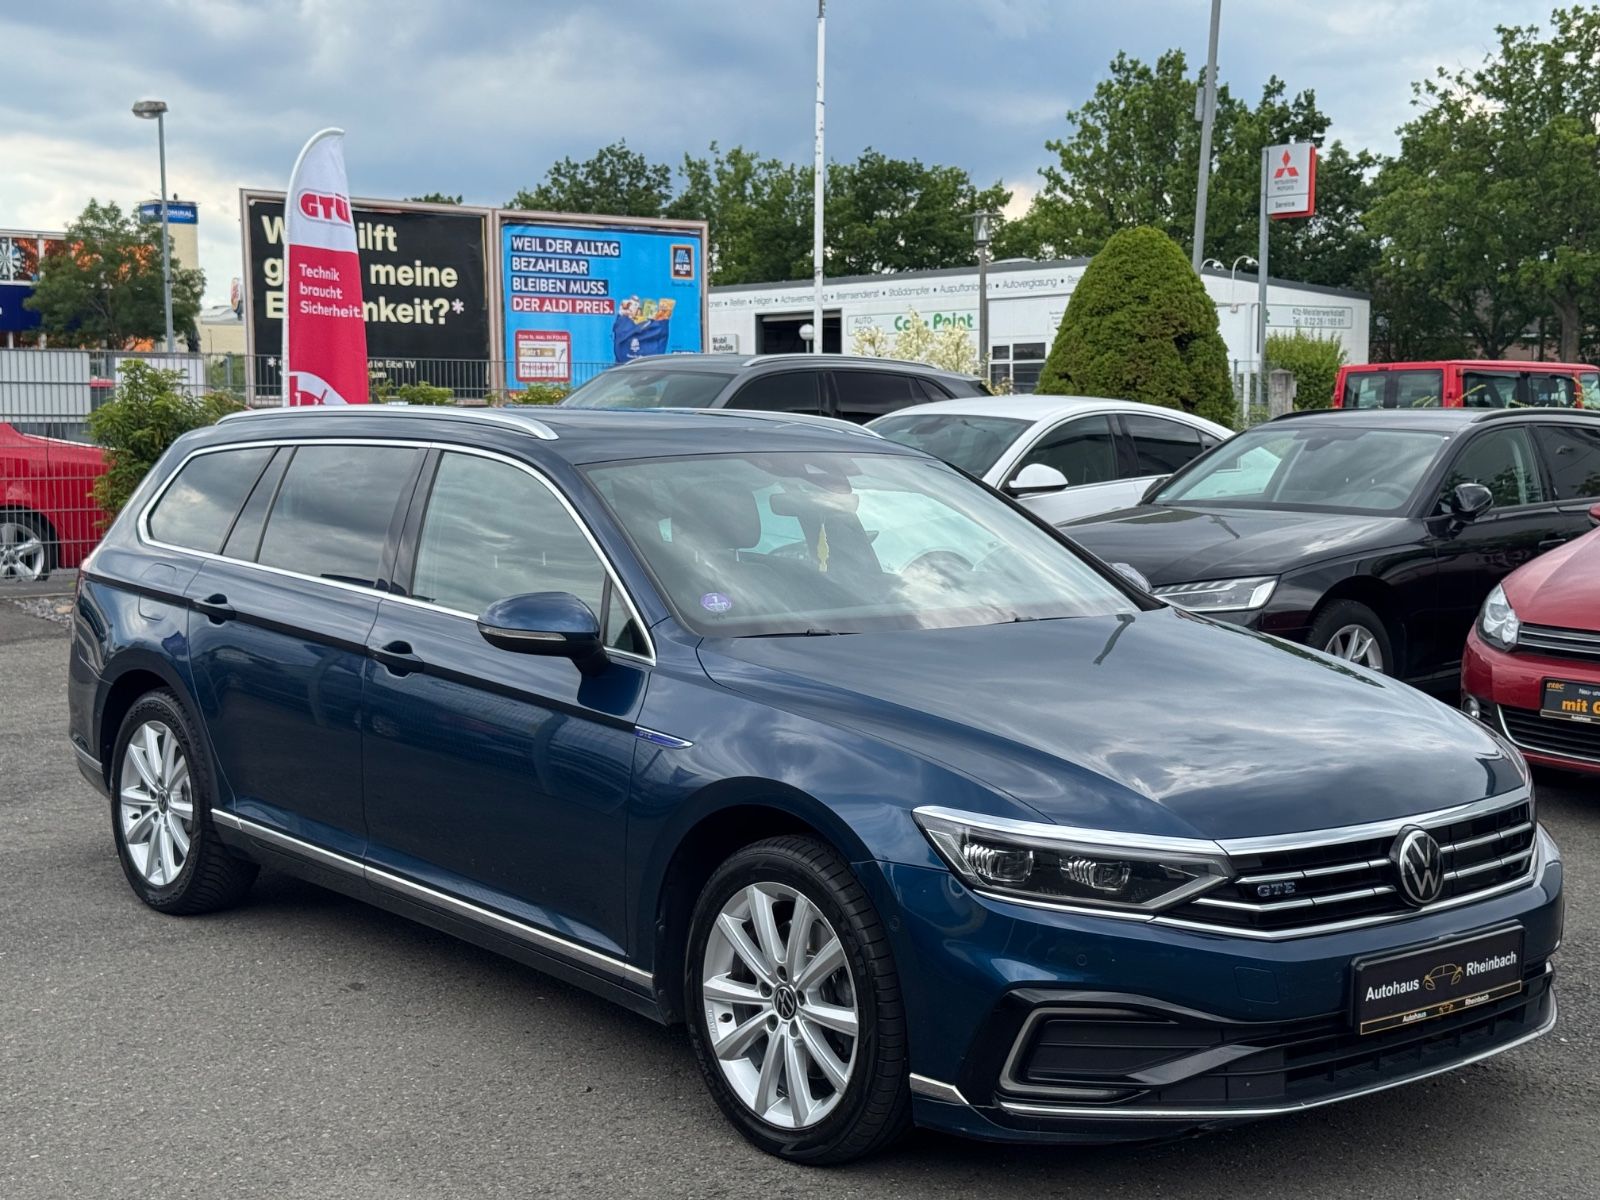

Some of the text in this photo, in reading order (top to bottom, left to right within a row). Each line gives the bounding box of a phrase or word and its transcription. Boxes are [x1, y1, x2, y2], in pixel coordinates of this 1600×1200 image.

[299, 192, 351, 223] GTÜ
[358, 222, 397, 251] ilft
[512, 236, 619, 256] WEIL DER ALLTAG
[299, 264, 340, 282] Technik
[370, 260, 458, 288] meine
[512, 257, 588, 274] BEZAHLBAR
[300, 282, 342, 300] braucht
[513, 277, 607, 295] BLEIBEN MUSS.
[889, 286, 929, 297] Stoßdämpfer
[1002, 278, 1057, 289] Autoverglasung
[300, 301, 364, 319] Sicherheit.
[513, 297, 613, 314] DER ALDI PREIS.
[405, 360, 416, 369] TV
[1562, 699, 1588, 713] mit
[1257, 881, 1296, 898] GTE
[1365, 951, 1517, 1002] Autohaus Rheinbach
